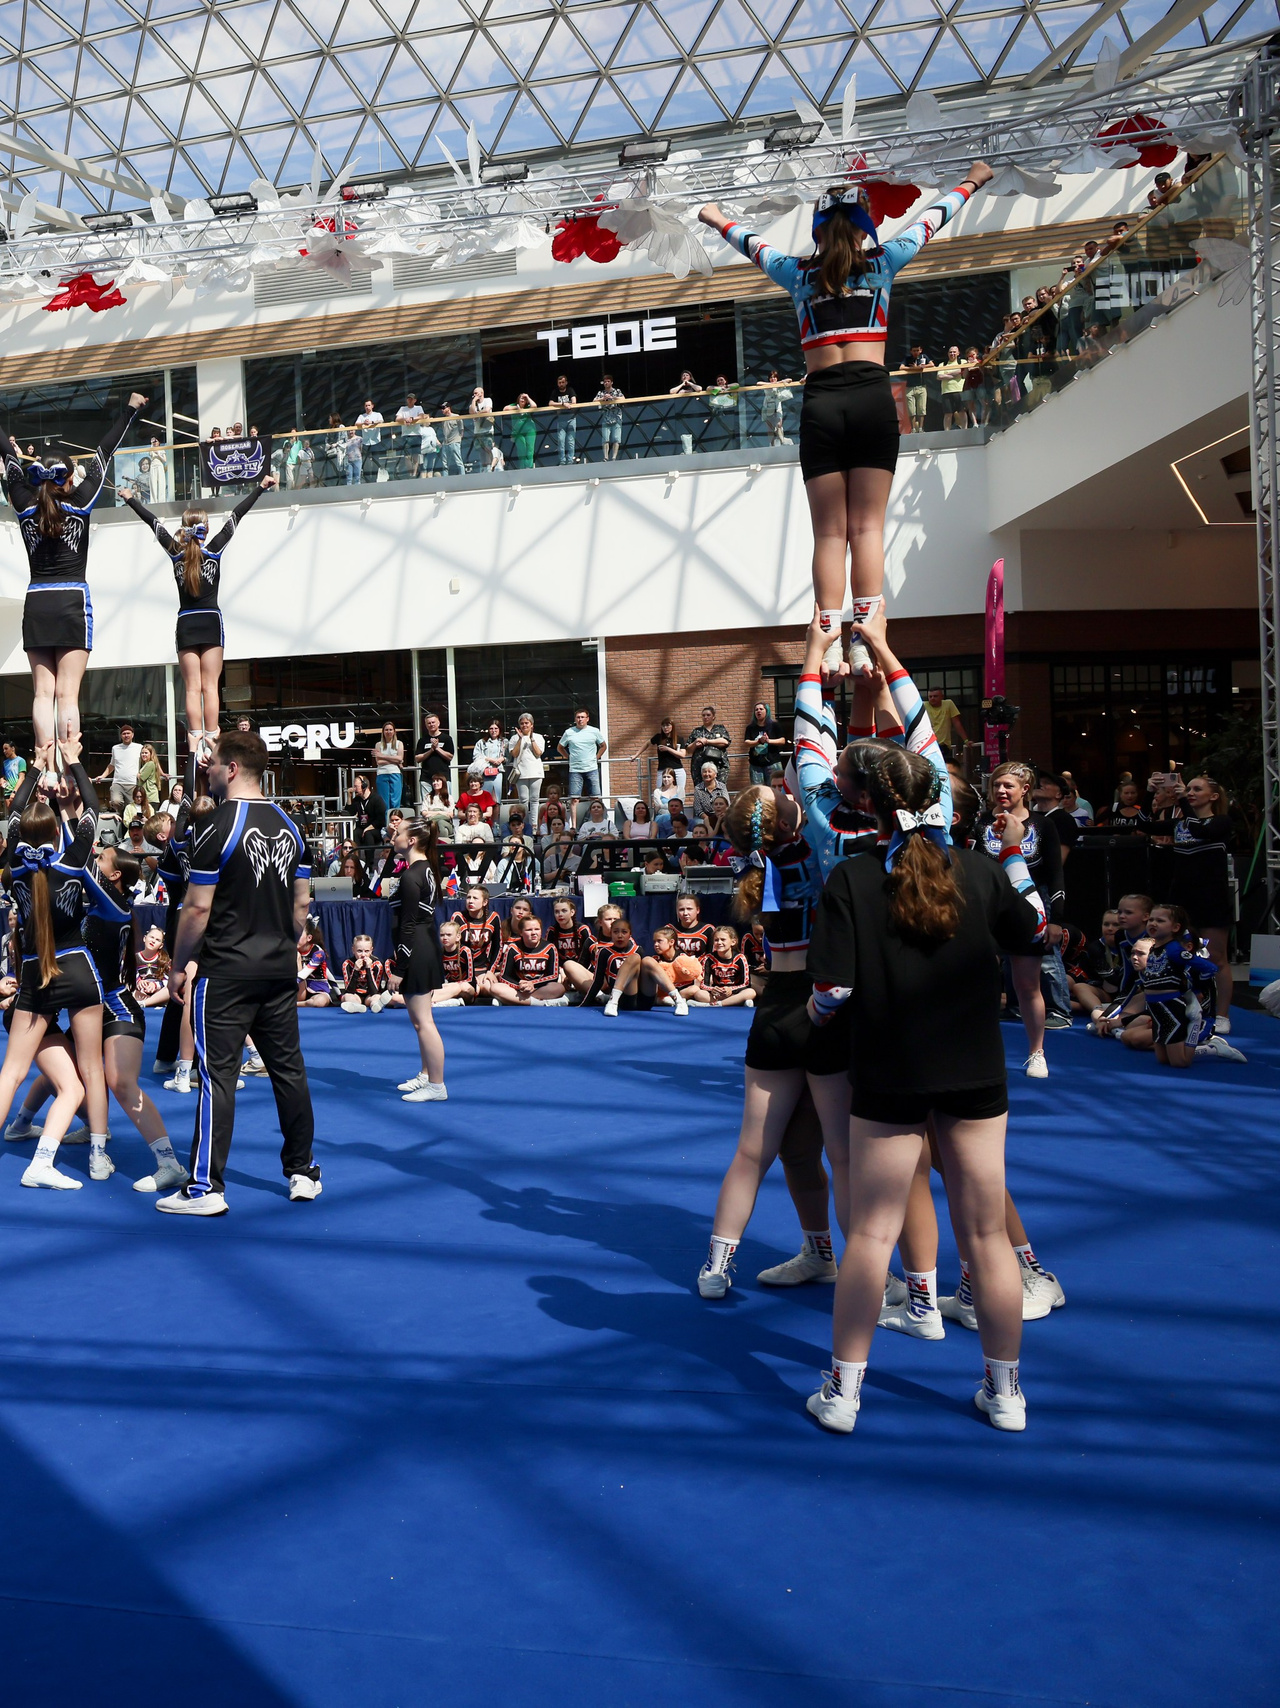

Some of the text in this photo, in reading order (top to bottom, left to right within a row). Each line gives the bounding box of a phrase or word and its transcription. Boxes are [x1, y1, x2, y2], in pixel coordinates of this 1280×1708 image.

[536, 316, 677, 362] ТВОЕ
[216, 462, 258, 474] CHEER FLY
[260, 722, 355, 752] ECRU
[900, 811, 910, 828] NRG
[930, 812, 941, 820] EK
[519, 959, 546, 970] FOXES
